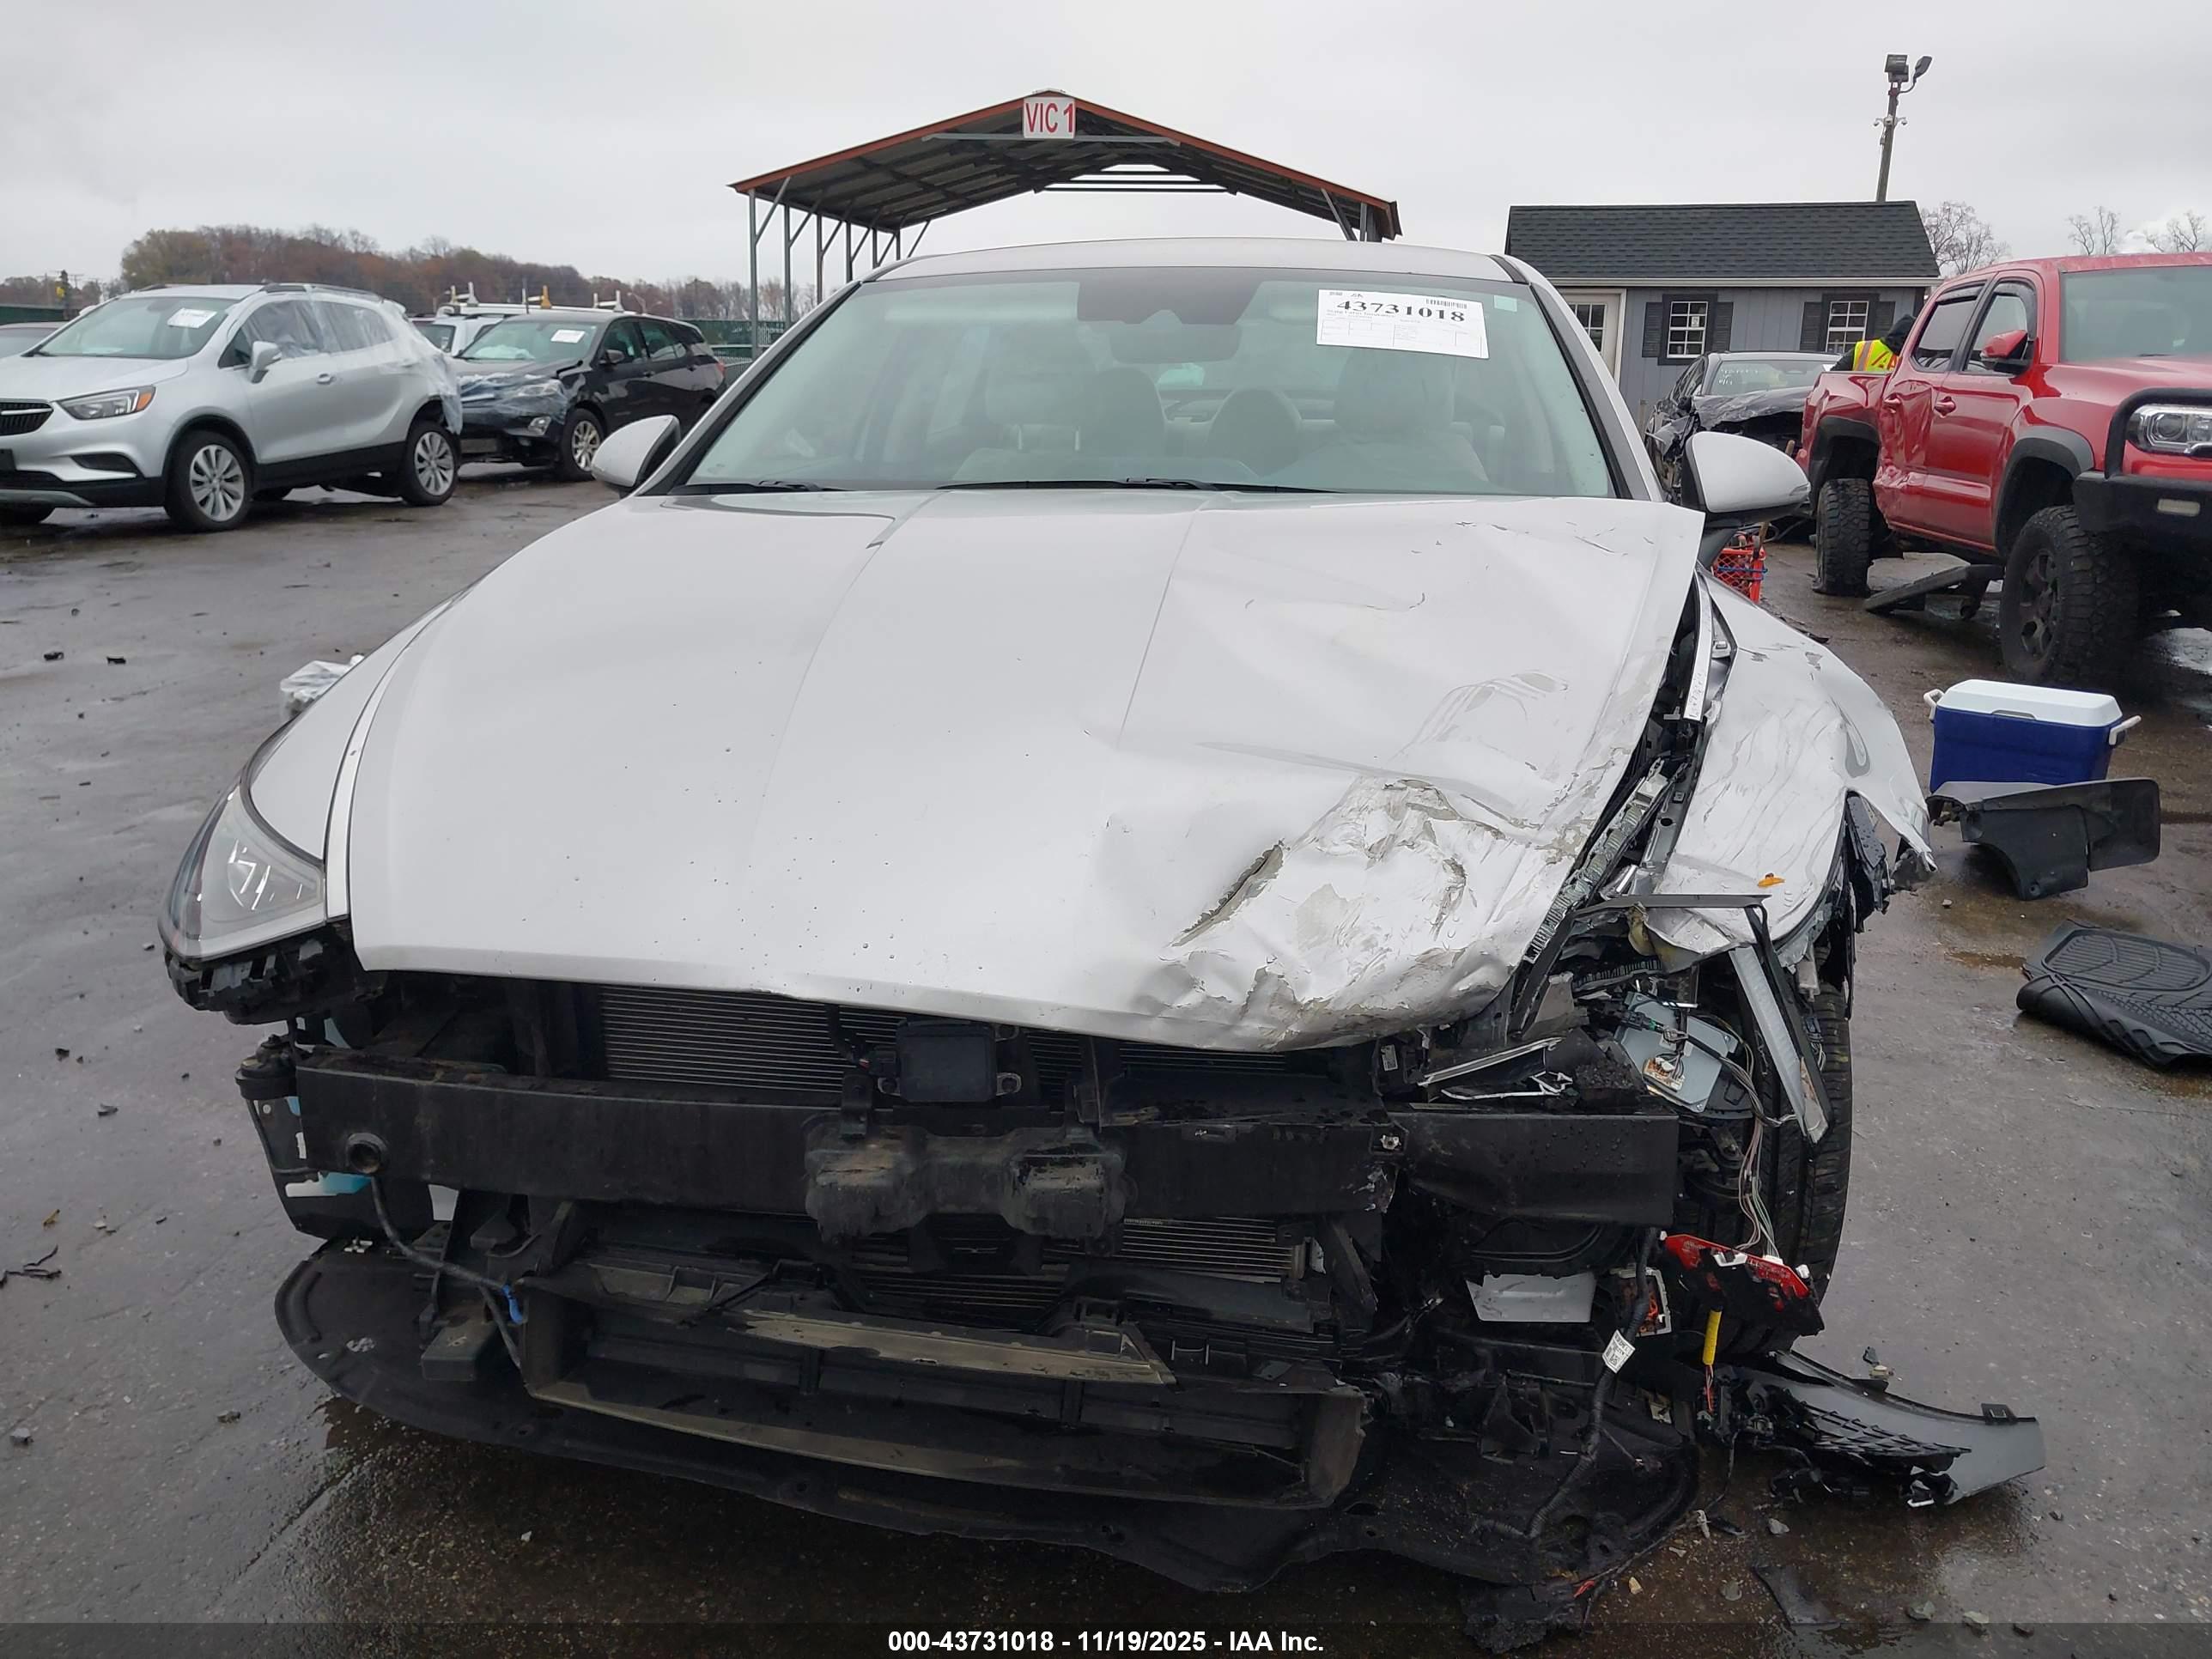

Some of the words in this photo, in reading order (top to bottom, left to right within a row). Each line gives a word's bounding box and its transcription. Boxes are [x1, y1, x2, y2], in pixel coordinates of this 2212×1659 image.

[1025, 102, 1058, 133] VIC
[1063, 102, 1073, 133] 1
[1336, 301, 1465, 322] 43731018
